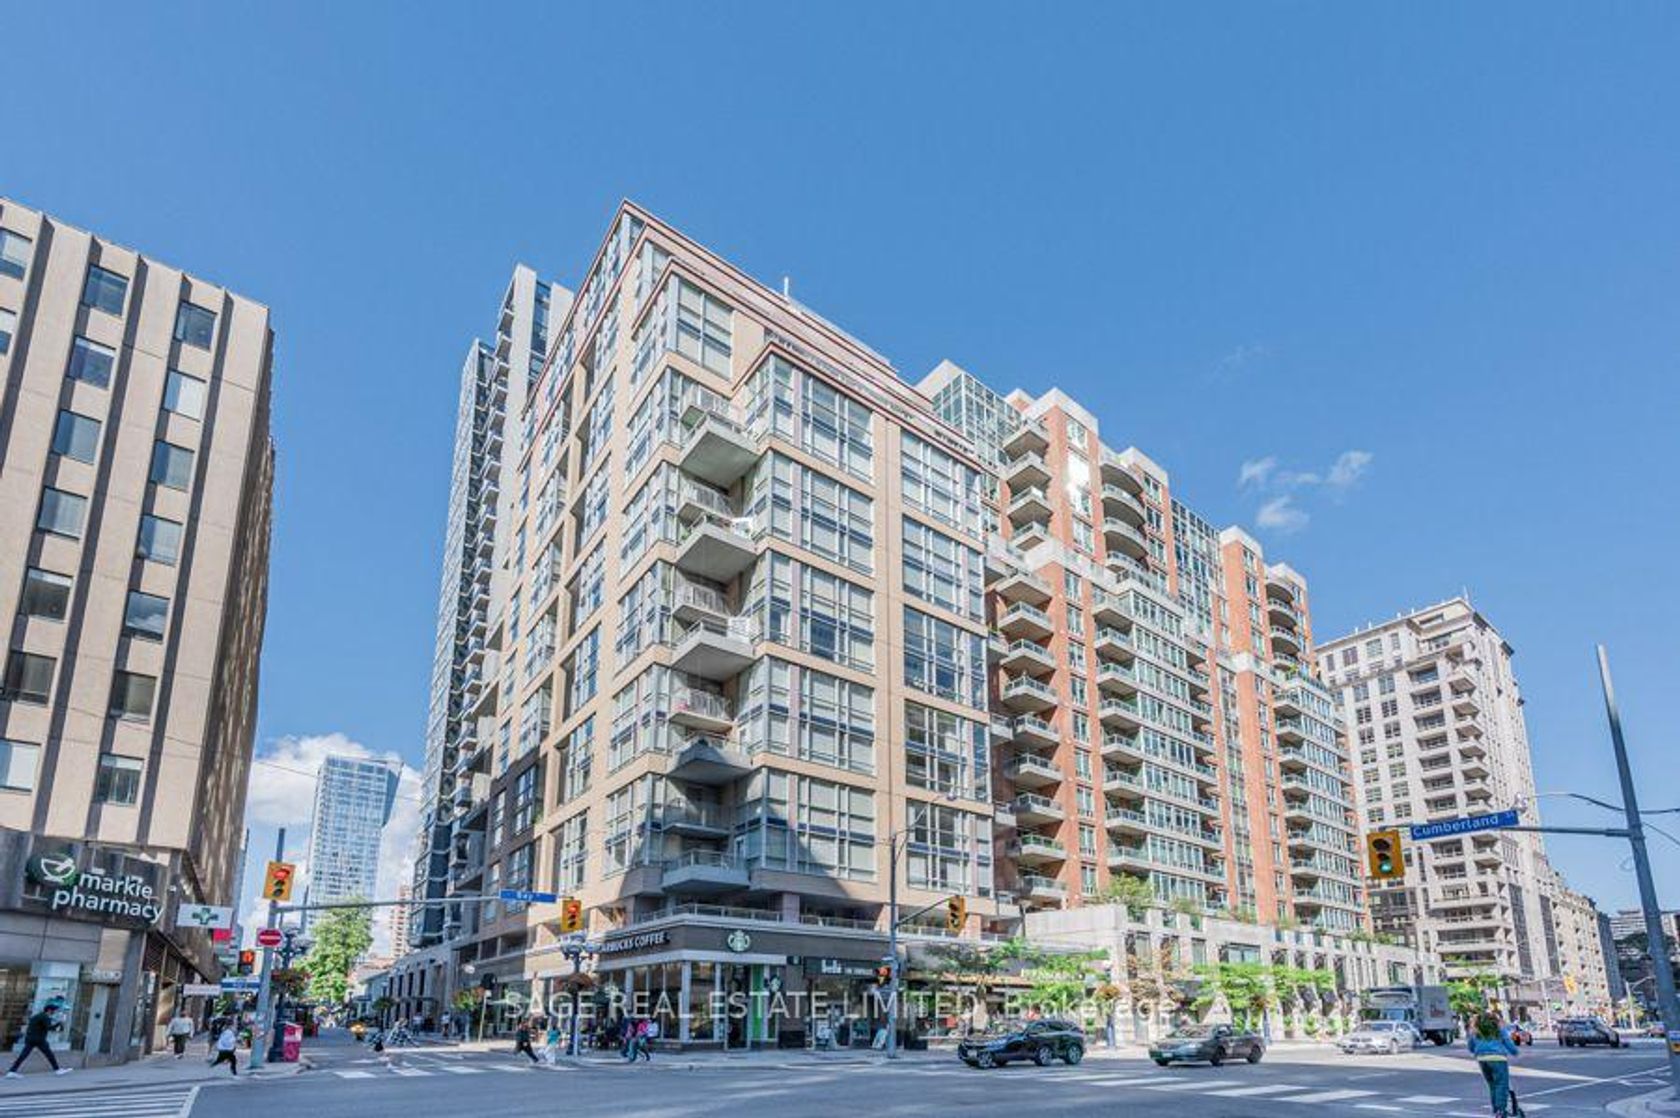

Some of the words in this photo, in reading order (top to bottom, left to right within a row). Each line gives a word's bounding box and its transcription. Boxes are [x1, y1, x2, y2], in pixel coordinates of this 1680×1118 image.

[1412, 814, 1499, 838] Cumberland
[79, 872, 153, 899] markie
[51, 885, 164, 924] pharmacy
[634, 931, 666, 948] COFFEE
